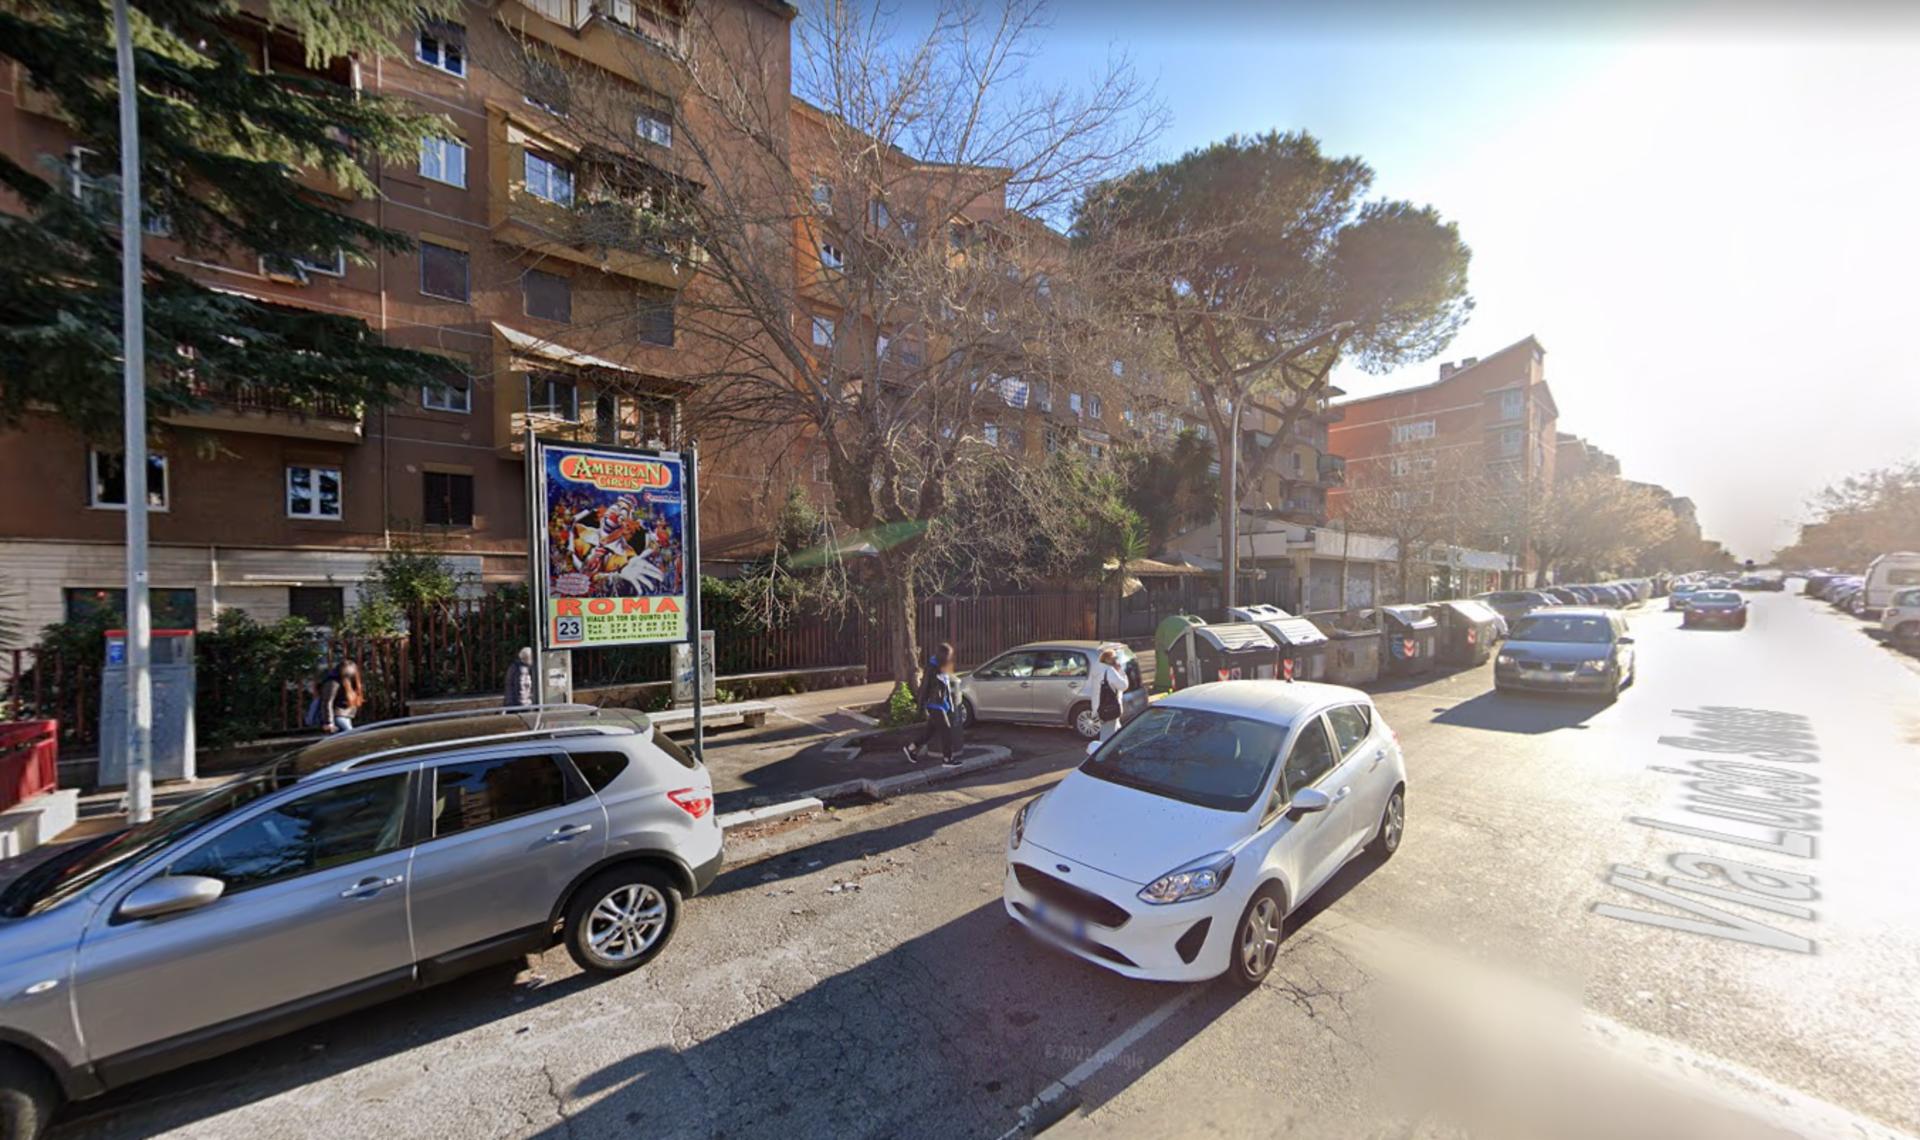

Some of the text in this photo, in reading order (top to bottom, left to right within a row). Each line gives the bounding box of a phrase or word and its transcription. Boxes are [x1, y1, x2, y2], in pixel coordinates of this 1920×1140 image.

[570, 455, 662, 485] AMERICAN
[598, 475, 639, 488] CIRCUS
[556, 598, 680, 616] ROMA
[559, 621, 580, 635] 23
